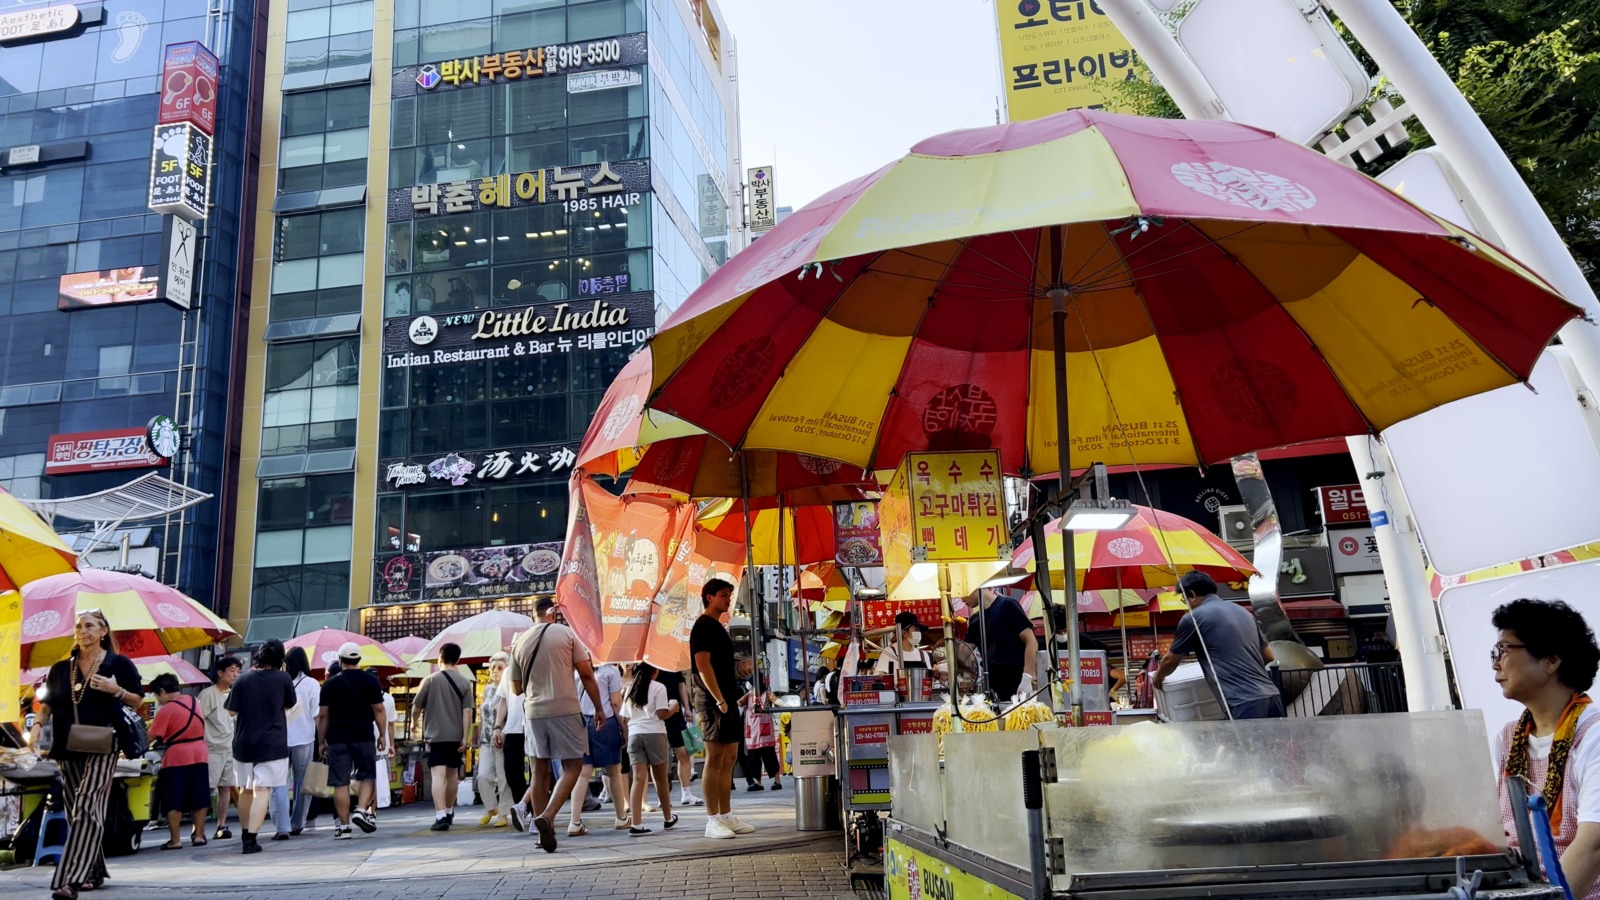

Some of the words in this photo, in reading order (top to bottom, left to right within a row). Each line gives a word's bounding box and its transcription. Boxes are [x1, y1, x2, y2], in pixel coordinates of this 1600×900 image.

[1, 9, 64, 25] Aesthetic
[440, 46, 545, 86] 박사부동산
[559, 39, 621, 69] 919-5500
[569, 76, 596, 88] NAVER
[176, 97, 191, 110] 6F
[201, 107, 213, 121] 6F
[160, 160, 178, 173] 5F
[189, 163, 203, 179] 5F
[156, 174, 181, 186] FOOT
[186, 176, 205, 194] FOOT
[751, 178, 770, 188] 박사
[563, 198, 598, 213] 1985
[602, 192, 641, 209] HAIR
[754, 188, 769, 220] 부동산
[443, 314, 475, 327] NEW
[471, 305, 548, 340] Little
[547, 300, 629, 333] India
[387, 348, 431, 369] Indian
[433, 344, 509, 364] Restaurant
[513, 342, 526, 356] &
[529, 339, 555, 355] Bar
[557, 337, 573, 353] 뉴
[55, 442, 72, 452] 24시
[55, 451, 72, 460] 무인
[916, 459, 994, 485] 옥수수
[919, 491, 998, 519] 고구마튀김
[1342, 511, 1367, 520] 051-
[921, 524, 1001, 552] 뻔데기
[922, 868, 955, 900] BUSAN
